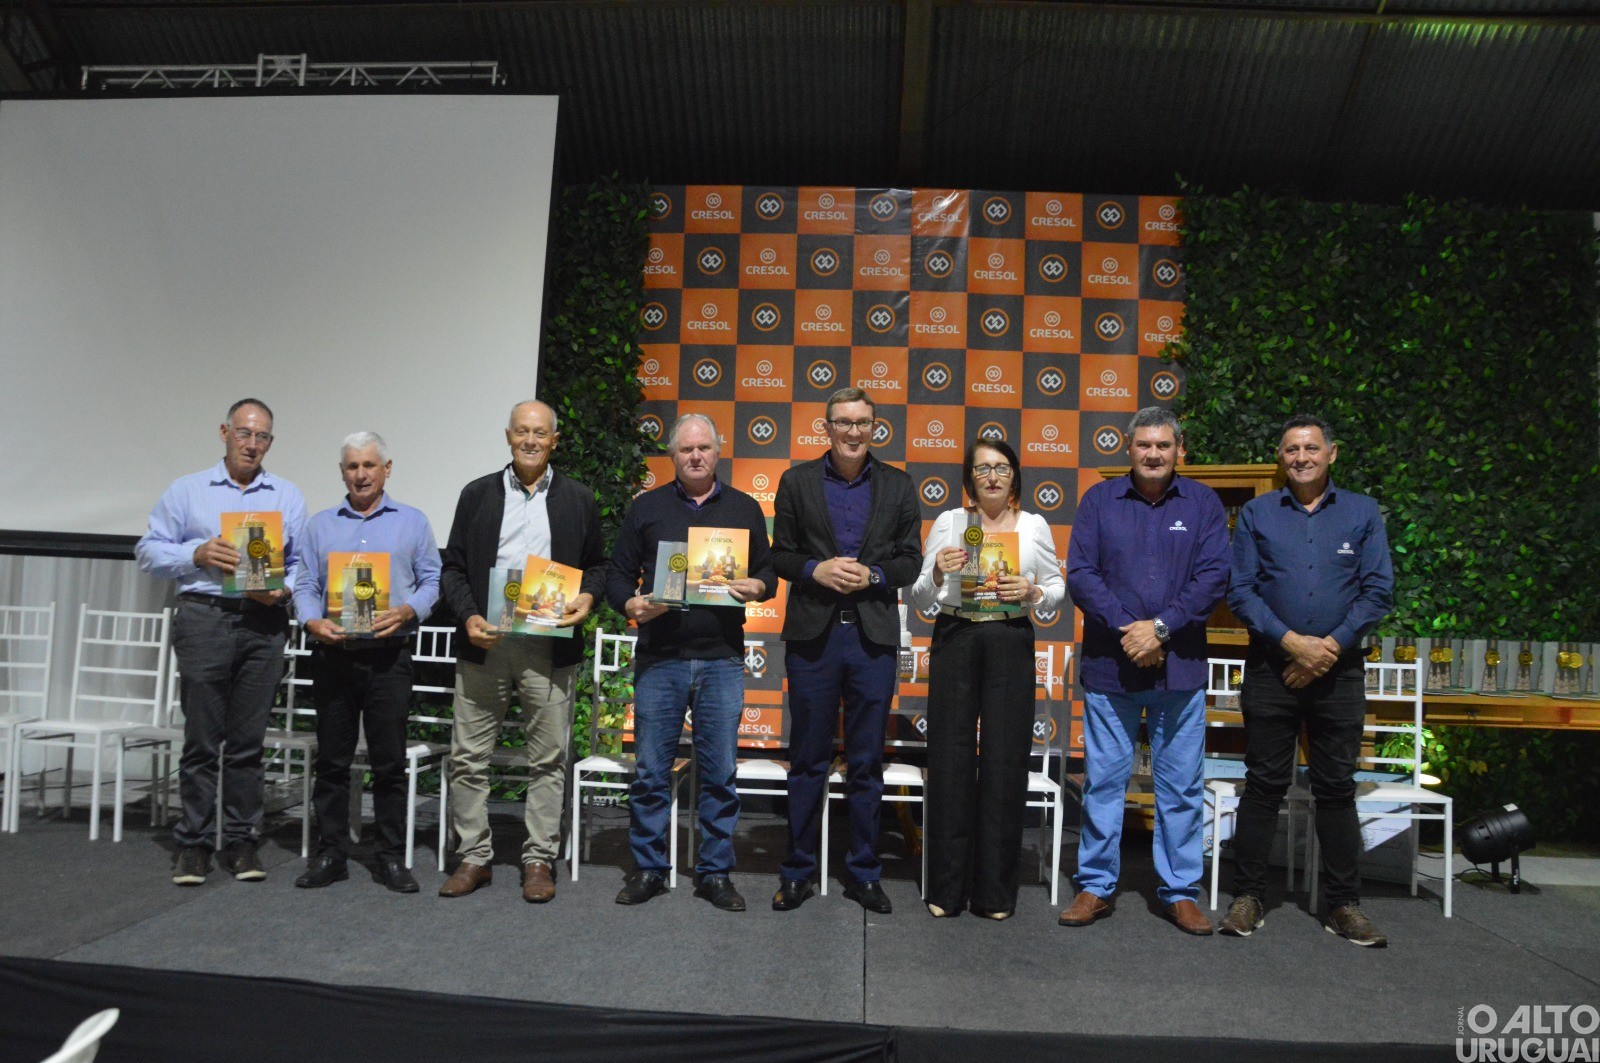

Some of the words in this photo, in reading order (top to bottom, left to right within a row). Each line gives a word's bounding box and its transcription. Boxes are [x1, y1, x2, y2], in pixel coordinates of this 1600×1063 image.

[691, 210, 734, 220] CRESOL
[804, 210, 848, 222] CRESOL
[917, 212, 961, 224] CRESOL
[1031, 216, 1076, 228] CRESOL
[1144, 221, 1181, 232] CRESO
[642, 265, 677, 275] RESOL
[745, 265, 789, 276] CRESOL
[859, 266, 904, 277] CRESOL
[973, 270, 1017, 281] CRESOL
[1087, 274, 1132, 286] CRESOL
[687, 320, 731, 331] CRESOL
[800, 322, 845, 333] CRESOL
[914, 323, 960, 335] CRESOL
[1029, 328, 1074, 340] CRESOL
[1143, 333, 1182, 343] CRESO
[742, 377, 786, 388] CRESOL
[857, 379, 901, 390] CRESOL
[971, 383, 1015, 394] CRESOL
[1086, 387, 1131, 398] CRESOL
[912, 438, 957, 449] CRESOL
[1027, 442, 1072, 453] CRESOL
[737, 723, 775, 734] RESOL
